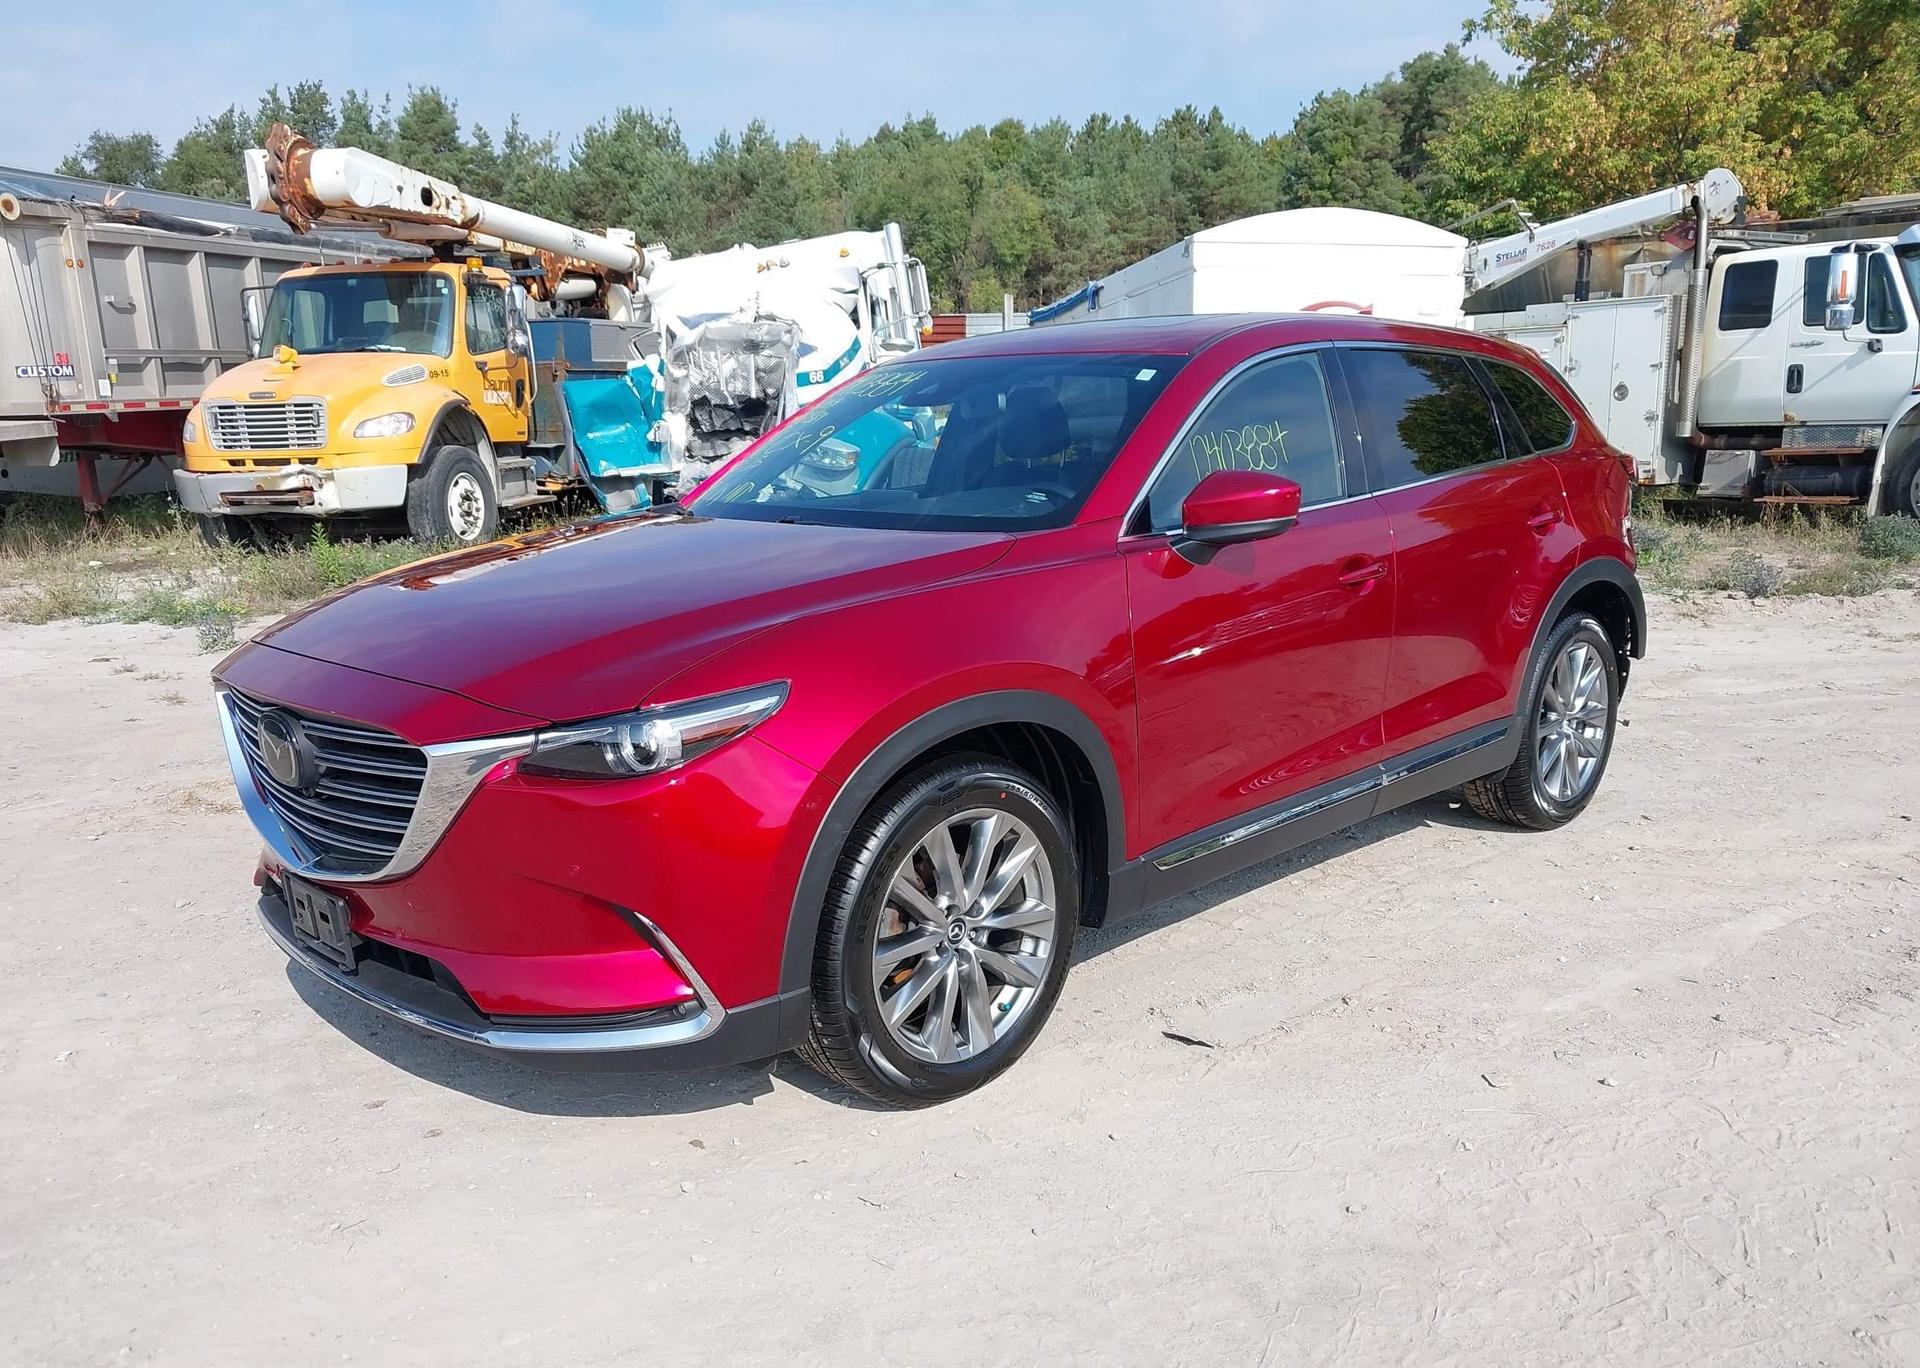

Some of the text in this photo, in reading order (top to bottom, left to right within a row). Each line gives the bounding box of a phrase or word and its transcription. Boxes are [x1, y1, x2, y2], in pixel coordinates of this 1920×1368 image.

[1536, 239, 1556, 252] 7628
[1495, 247, 1528, 262] STELLAR
[18, 366, 73, 377] CUSTOM
[428, 368, 450, 379] 09-15
[808, 371, 825, 384] 66
